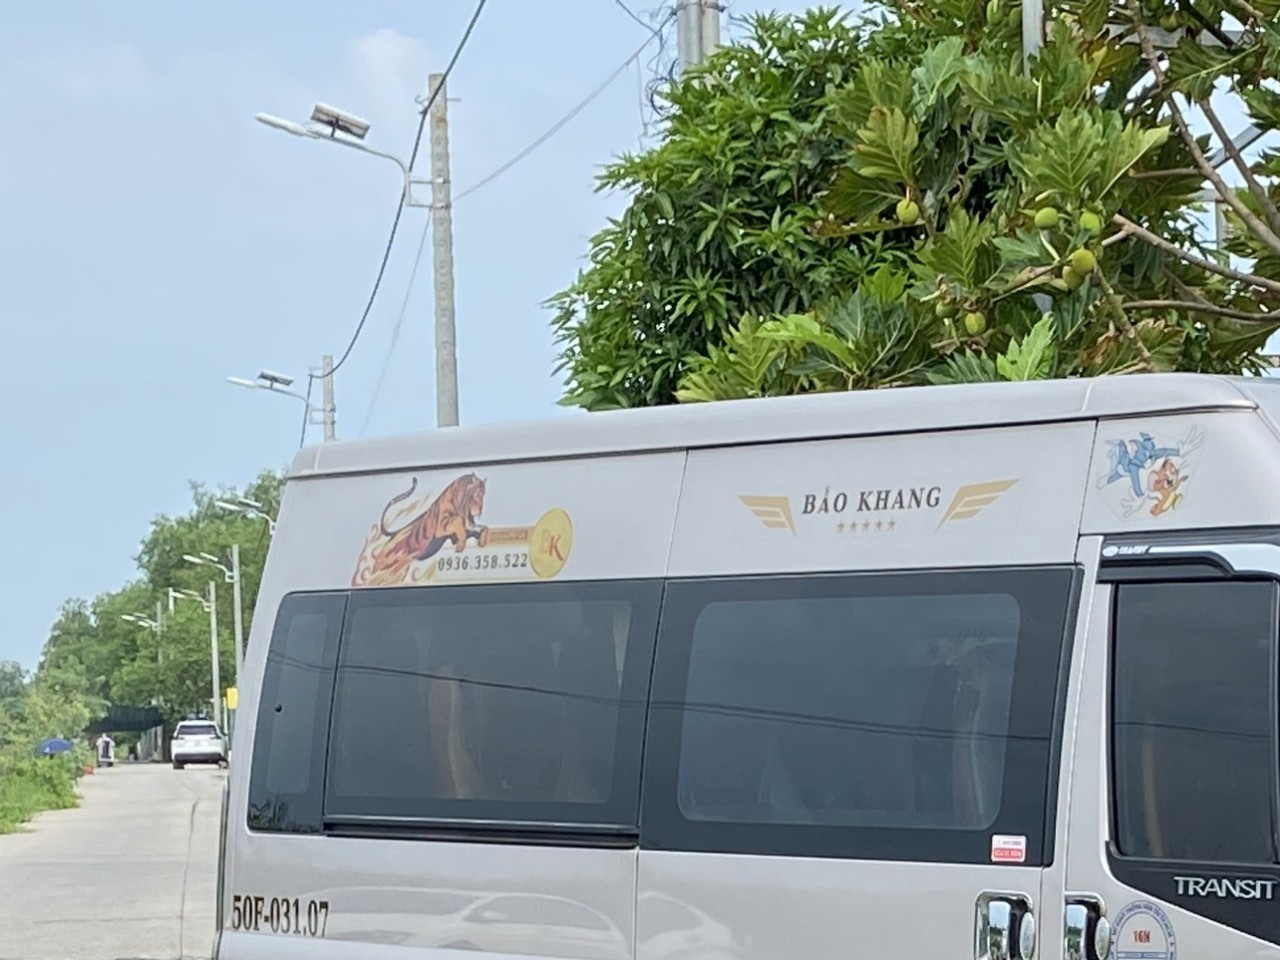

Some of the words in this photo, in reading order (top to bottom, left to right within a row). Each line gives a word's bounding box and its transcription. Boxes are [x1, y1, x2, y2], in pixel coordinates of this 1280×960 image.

[802, 486, 847, 514] BẢO
[857, 487, 941, 512] KHANG
[437, 553, 528, 571] 0936.358.522
[1173, 876, 1279, 899] TRANSIT
[232, 895, 329, 937] 50F-031.07
